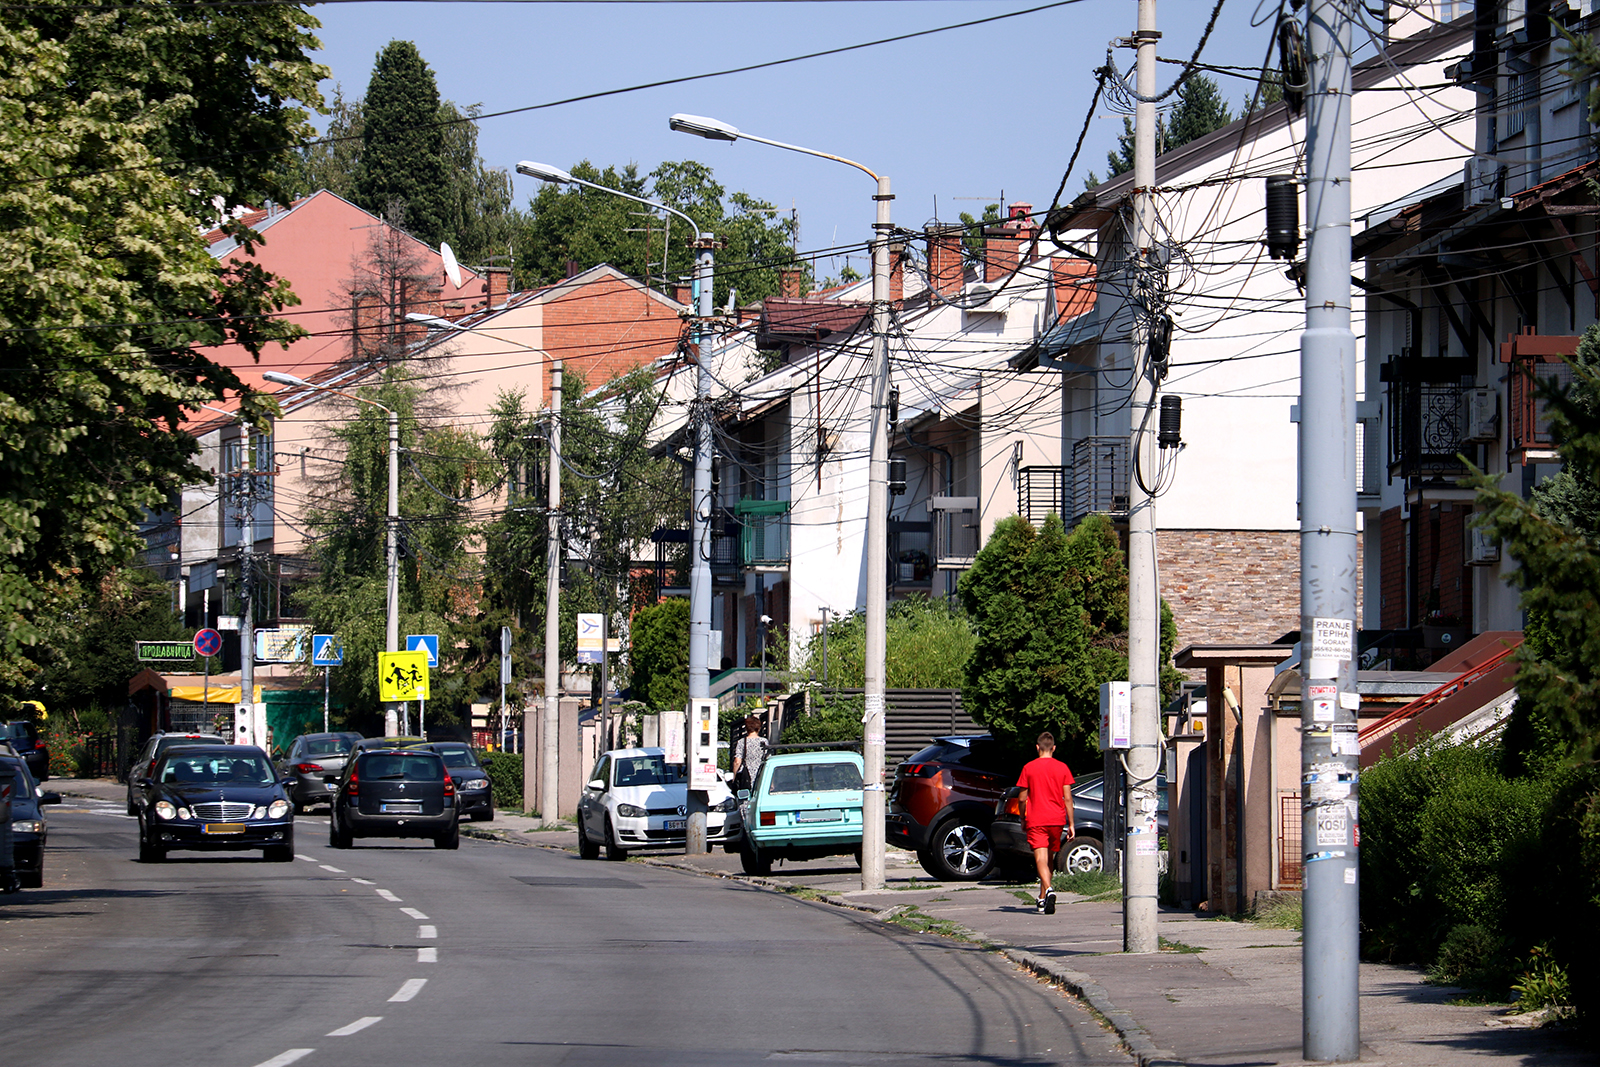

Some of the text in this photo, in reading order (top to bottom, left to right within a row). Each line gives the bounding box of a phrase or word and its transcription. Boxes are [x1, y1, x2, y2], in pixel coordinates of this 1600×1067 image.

[1316, 621, 1351, 630] PRANJE
[1318, 629, 1349, 638] TEPIHA
[142, 645, 191, 659] ПРОДАВНИЦА
[1318, 820, 1346, 831] KOSU
